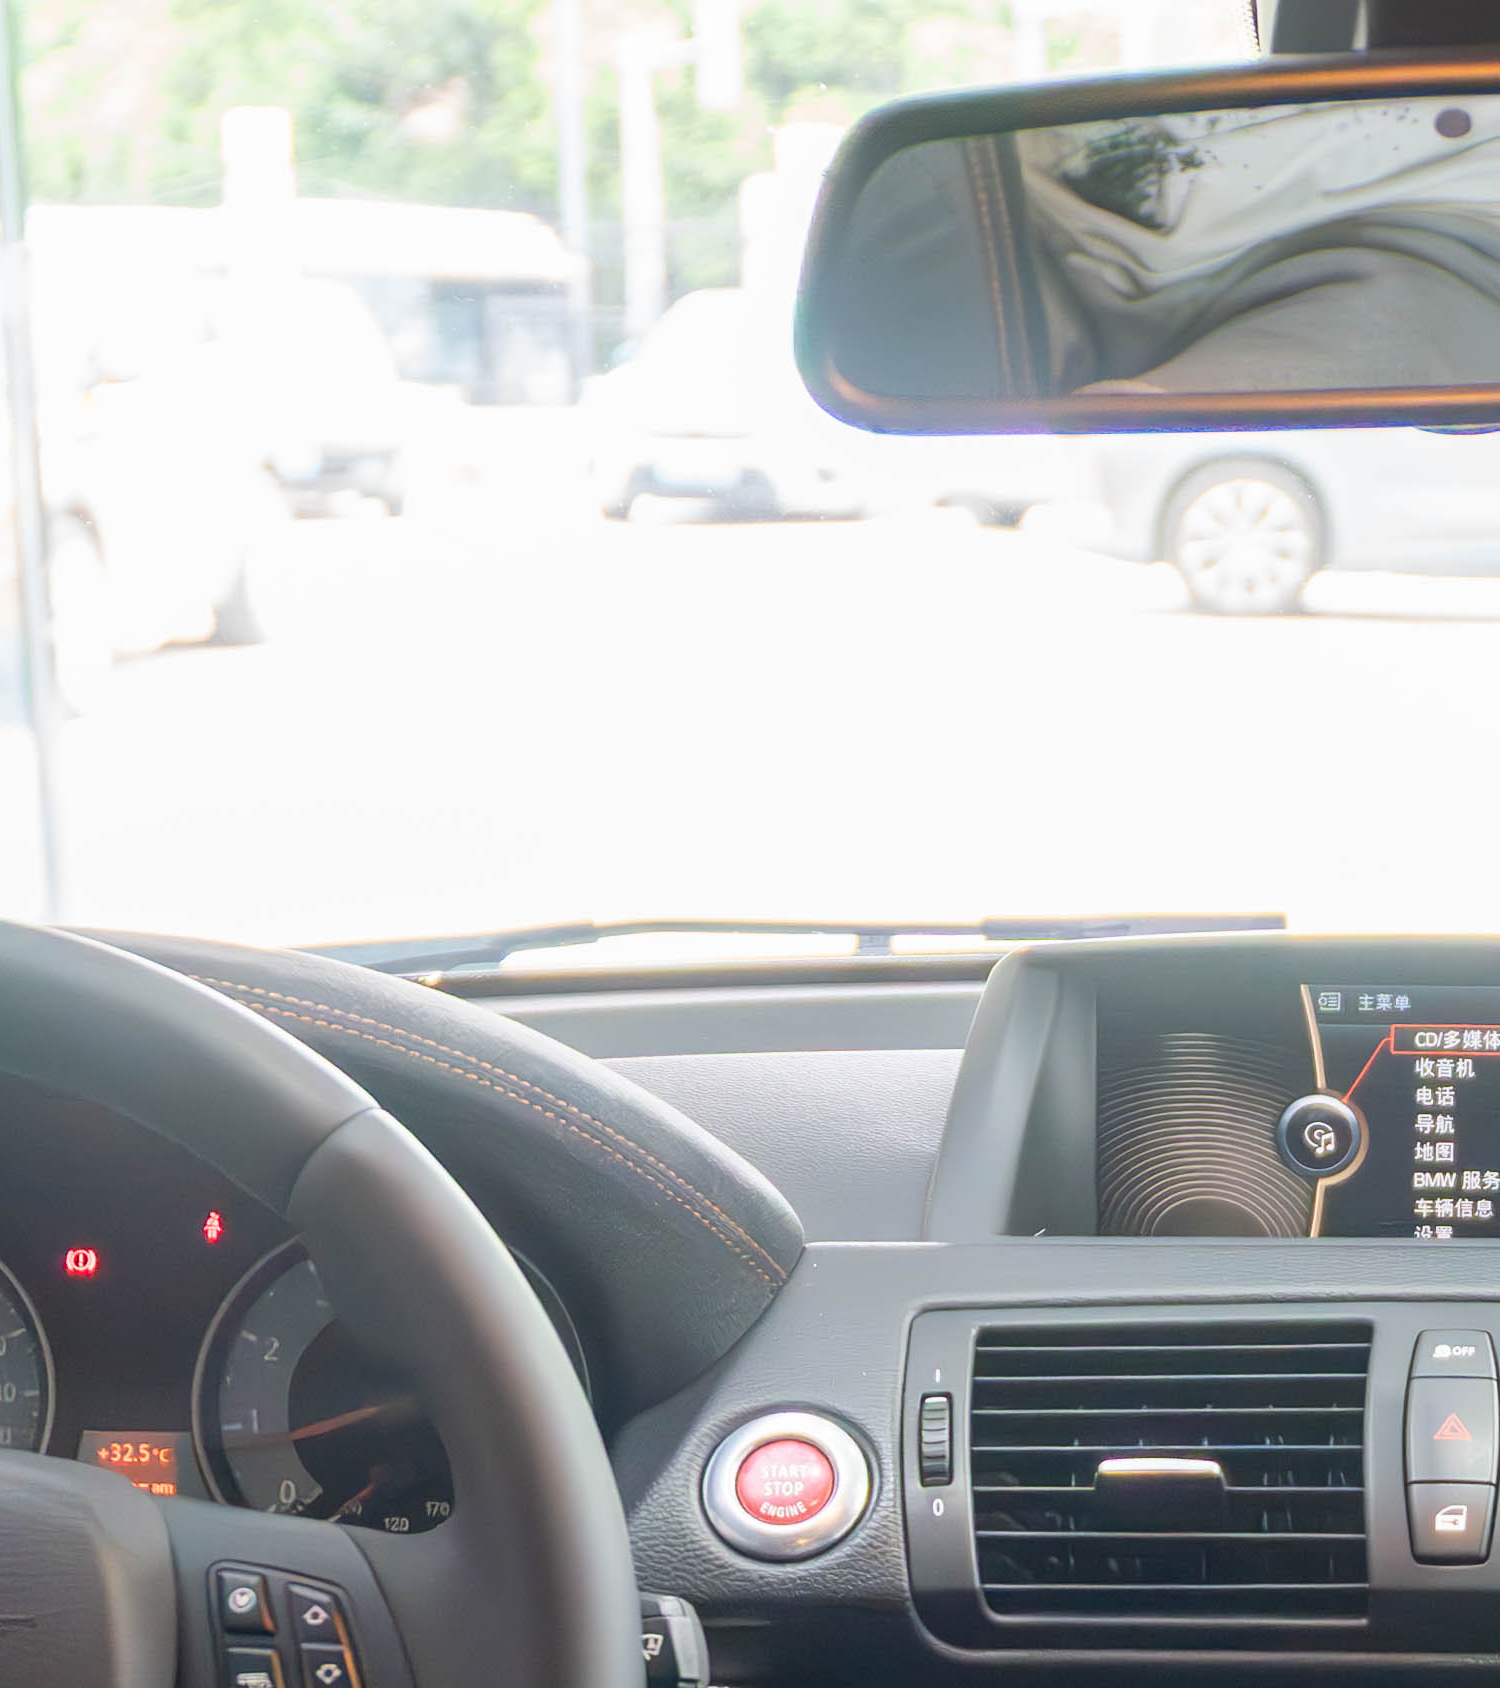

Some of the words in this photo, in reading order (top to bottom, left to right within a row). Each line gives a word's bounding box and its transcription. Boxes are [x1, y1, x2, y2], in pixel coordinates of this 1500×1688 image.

[1358, 993, 1411, 1012] 主菜单
[1414, 1056, 1477, 1079] 收音机
[1414, 1086, 1456, 1107] 电话
[1414, 1114, 1455, 1135] 导航
[1414, 1142, 1455, 1163] 地图
[1413, 1172, 1457, 1188] BMW
[1414, 1198, 1493, 1218] 车辆信息
[263, 1336, 280, 1361] 2
[1452, 1346, 1476, 1357] OFF
[760, 1464, 807, 1480] START
[279, 1479, 296, 1504] 0
[763, 1481, 805, 1497] STOP
[759, 1501, 808, 1519] ENGINE
